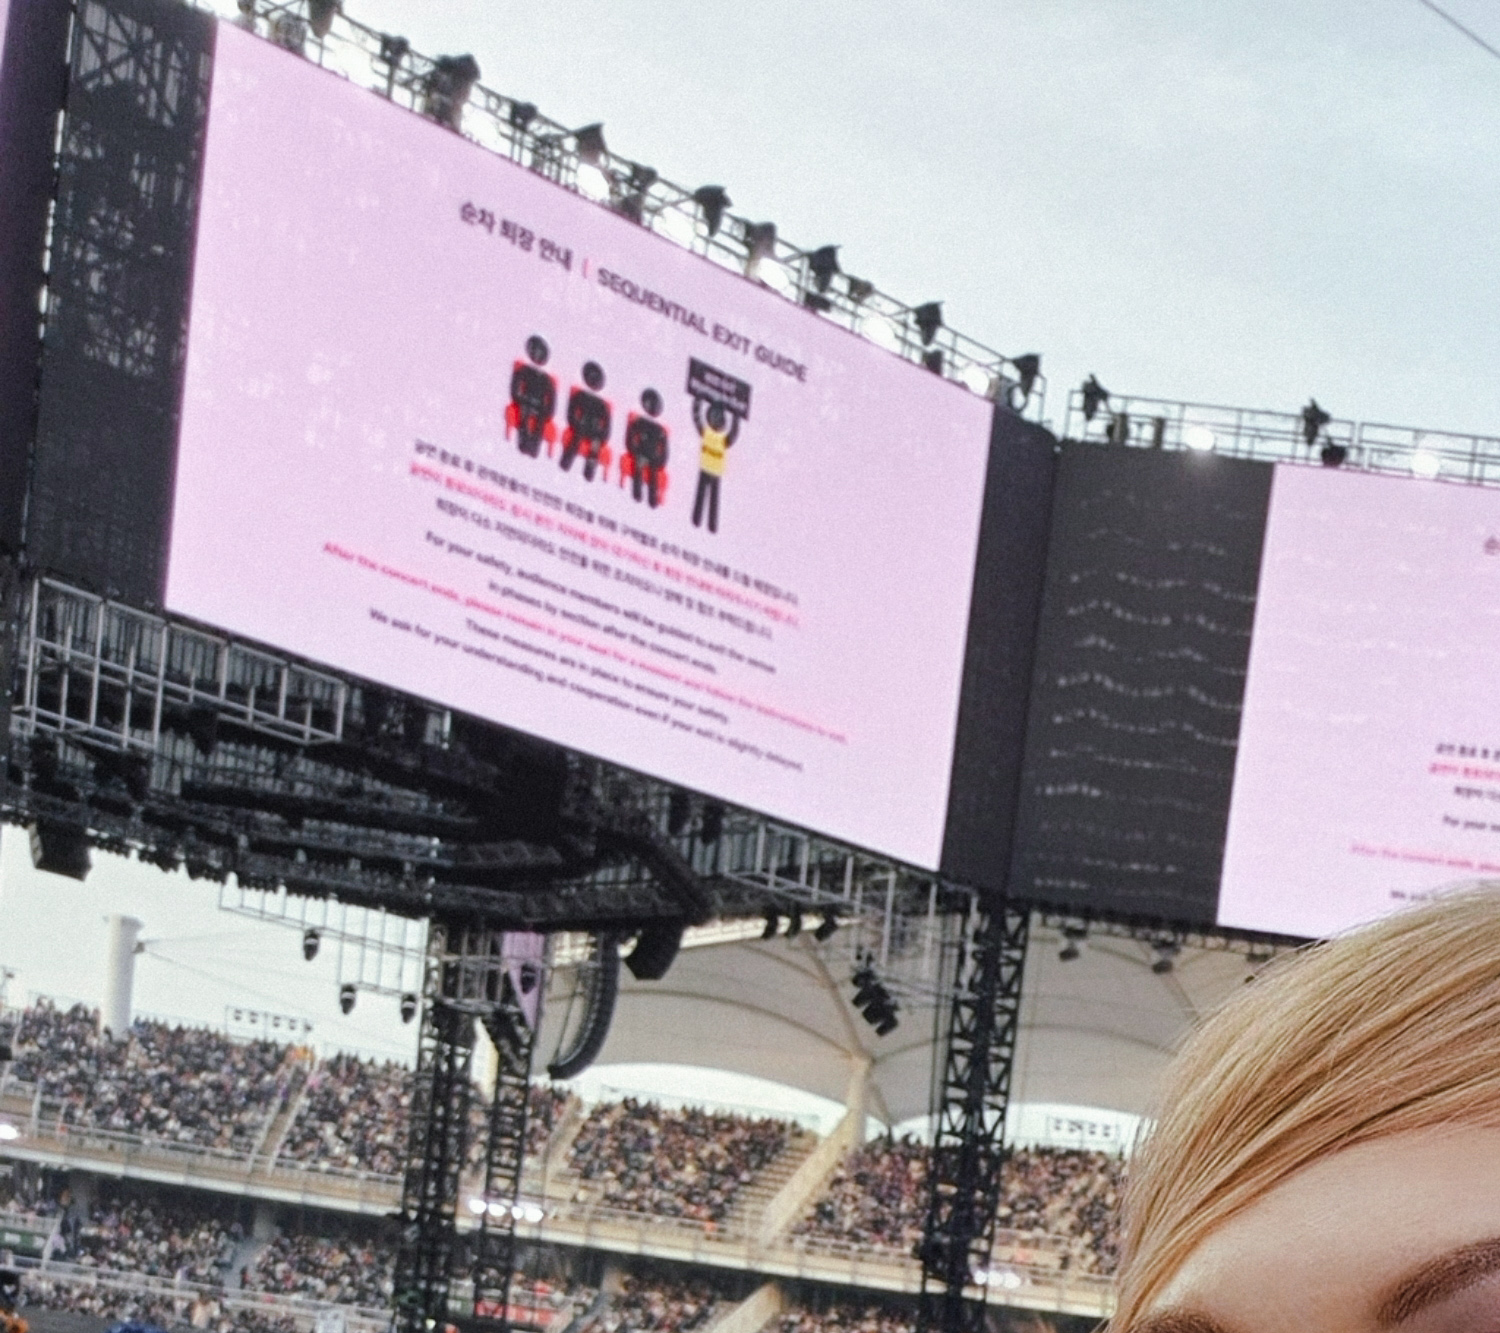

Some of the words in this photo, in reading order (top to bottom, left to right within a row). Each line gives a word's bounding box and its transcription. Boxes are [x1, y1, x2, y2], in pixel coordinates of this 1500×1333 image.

[459, 198, 494, 235] 순차
[499, 216, 534, 254] 퇴장
[538, 235, 573, 272] 안내
[596, 266, 709, 337] SEQUENTIAL
[711, 321, 749, 356] EXIT
[754, 342, 808, 384] GUIDE
